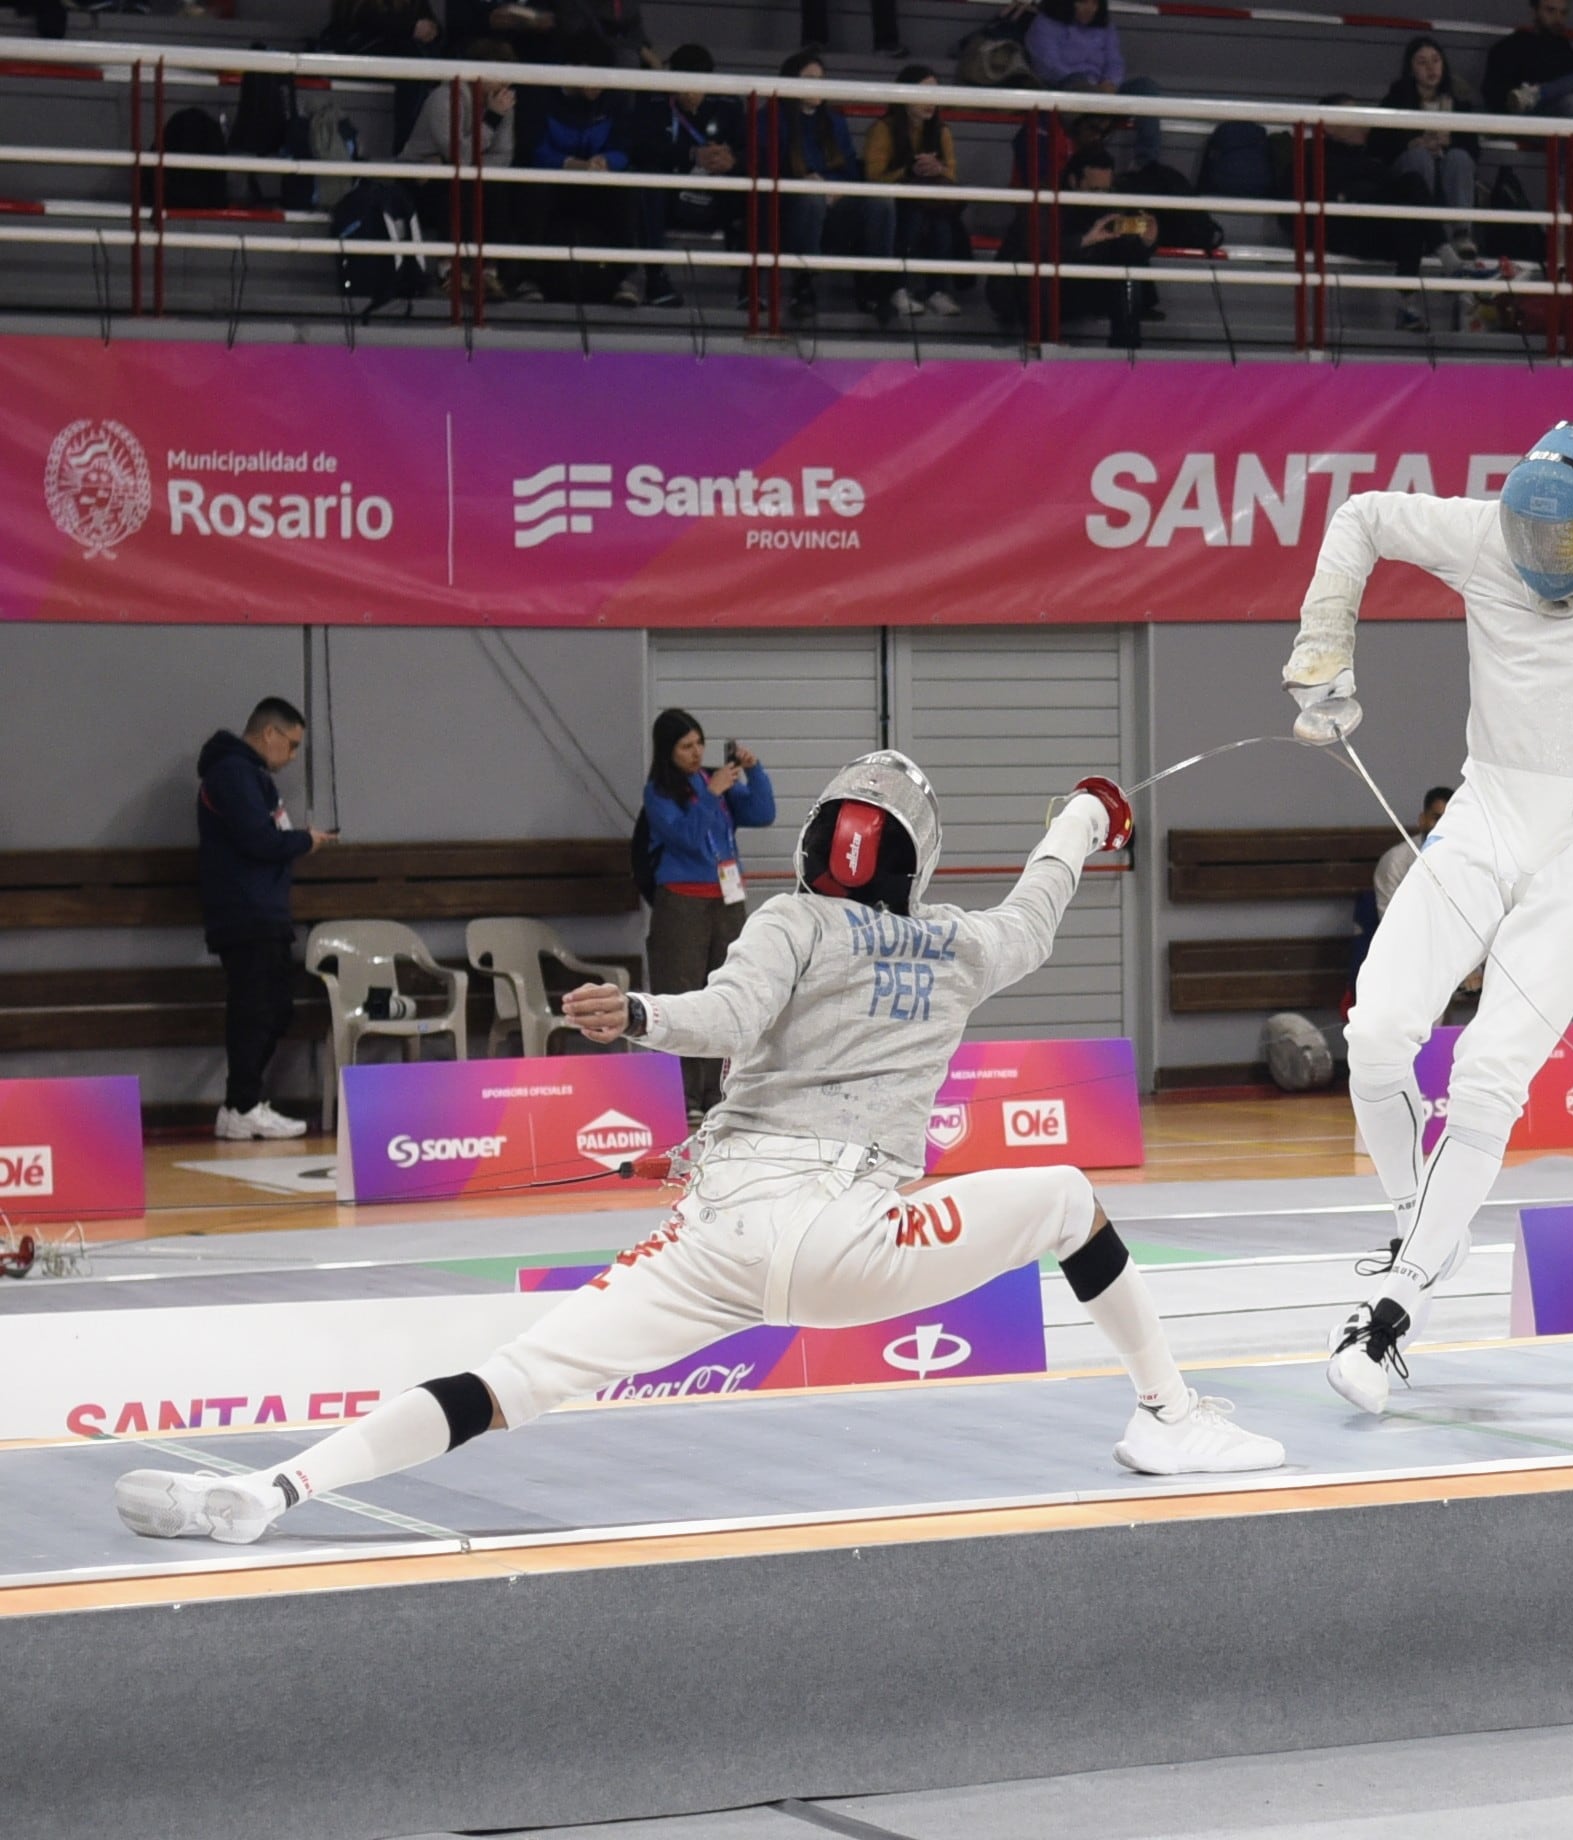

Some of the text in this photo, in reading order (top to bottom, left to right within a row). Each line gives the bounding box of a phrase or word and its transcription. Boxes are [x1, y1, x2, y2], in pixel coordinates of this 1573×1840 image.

[167, 449, 338, 476] Municipalidad de
[625, 465, 865, 517] Santa Fe
[167, 479, 393, 540] Rosario
[746, 530, 861, 550] PROVINCIA
[868, 961, 935, 1021] PER
[482, 1084, 573, 1099] SPONSORS OFICIALES
[1011, 1107, 1059, 1137] Olé
[576, 1131, 652, 1150] PALADINI
[66, 1395, 287, 1437] SANTA
